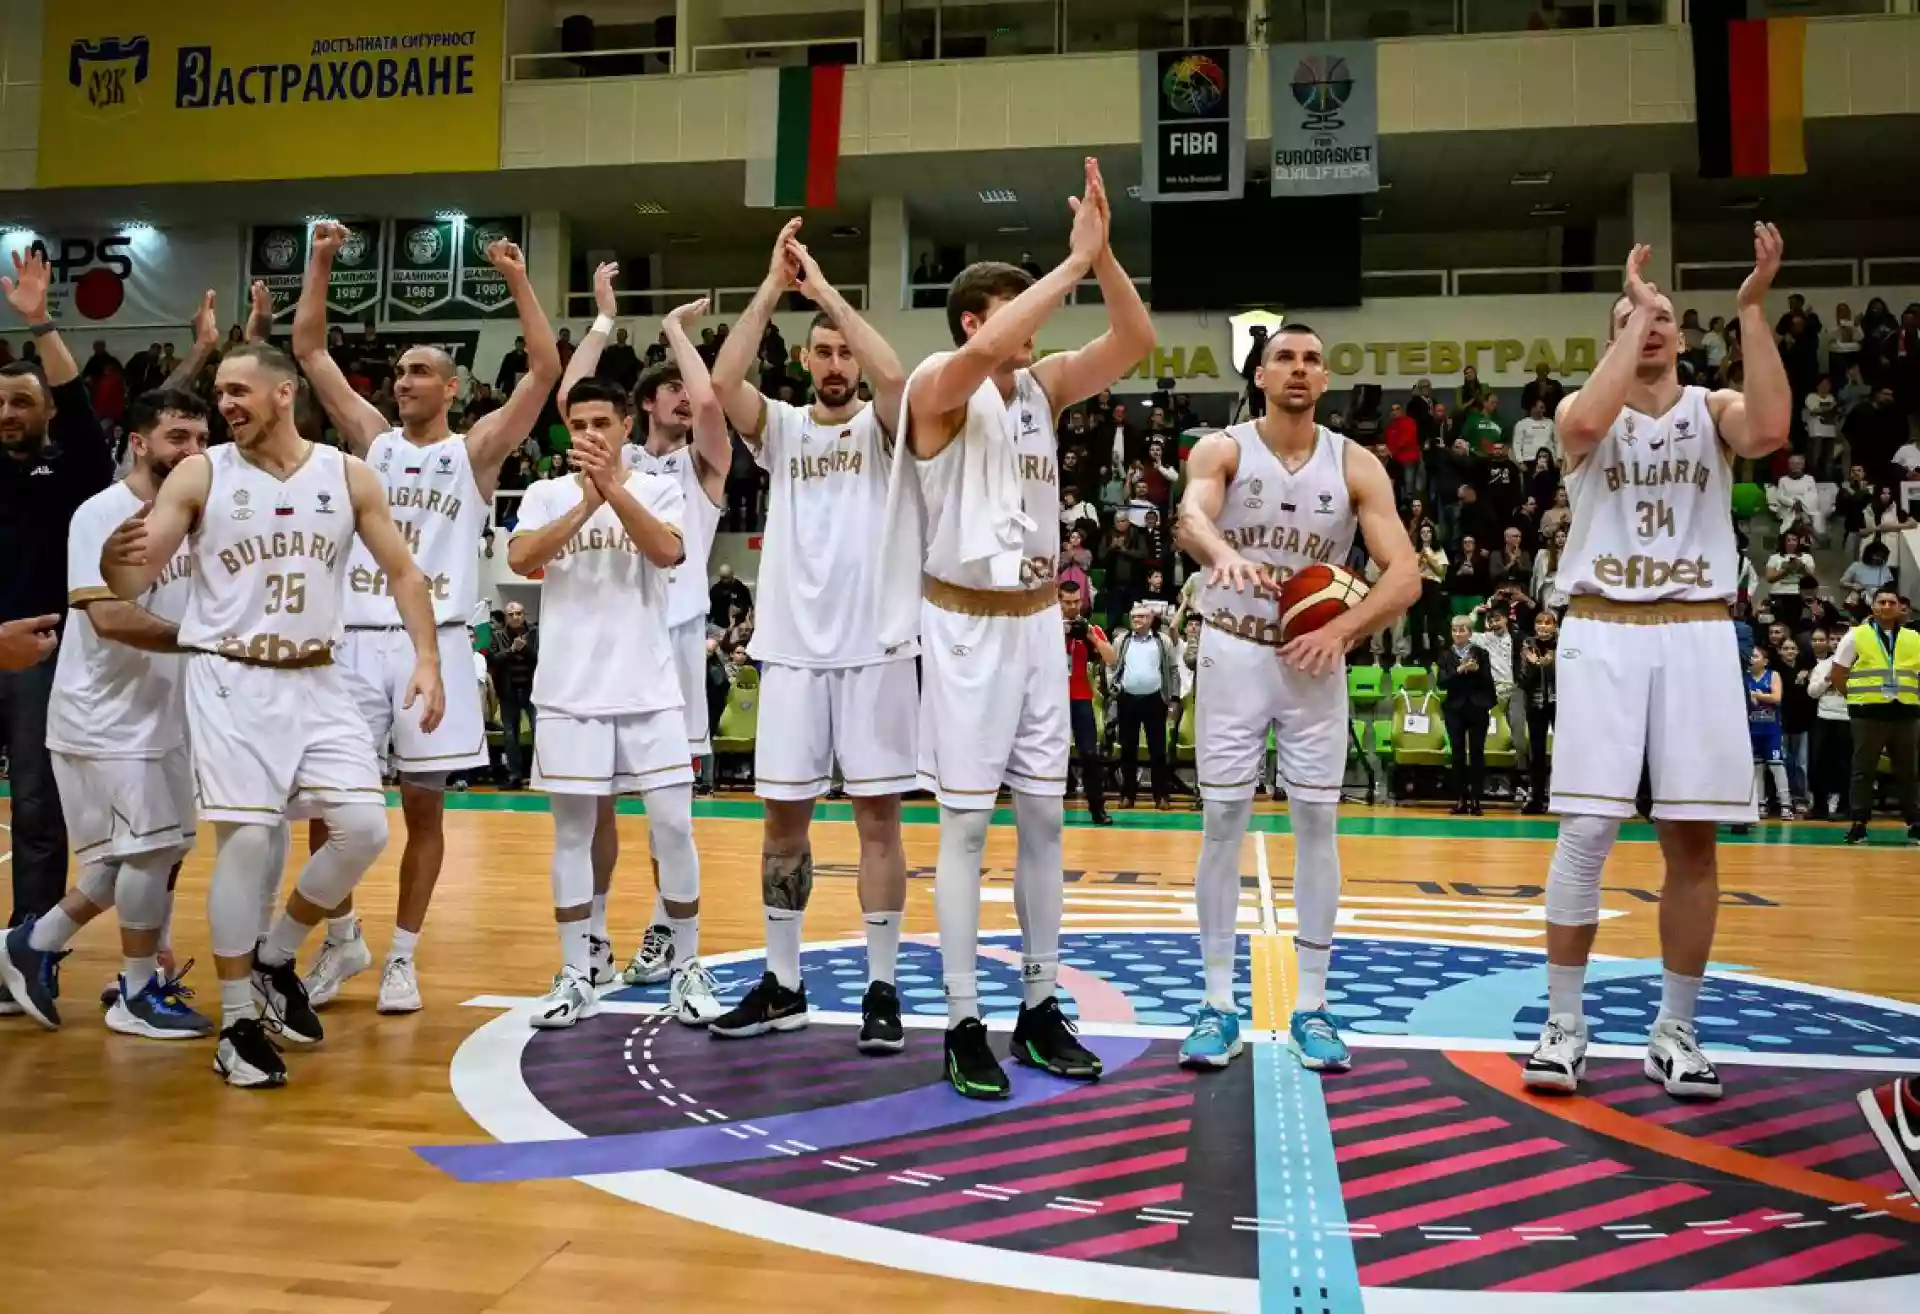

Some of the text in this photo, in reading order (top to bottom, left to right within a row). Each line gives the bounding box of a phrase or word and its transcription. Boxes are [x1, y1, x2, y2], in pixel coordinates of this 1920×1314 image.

[311, 31, 476, 56] ДОСТЪПНАТА СИГУРНОСТ
[178, 50, 475, 107] ЗАСТРАХОВАНЕ
[1169, 131, 1218, 156] FIBA
[1276, 146, 1372, 165] EUROBASKET
[1275, 164, 1372, 181] QUALIFIERS
[329, 271, 377, 281] АМПИОН
[464, 269, 505, 279] ШАМПИ
[403, 286, 436, 298] 1988
[1329, 337, 1599, 377] ОТЕВГРАД
[388, 486, 462, 522] LGARIA
[1635, 499, 1676, 538] 34
[395, 519, 422, 555] 4
[549, 526, 639, 560] ULGAR
[265, 572, 306, 615] 35
[349, 563, 451, 601] eft
[217, 632, 338, 662] efbe
